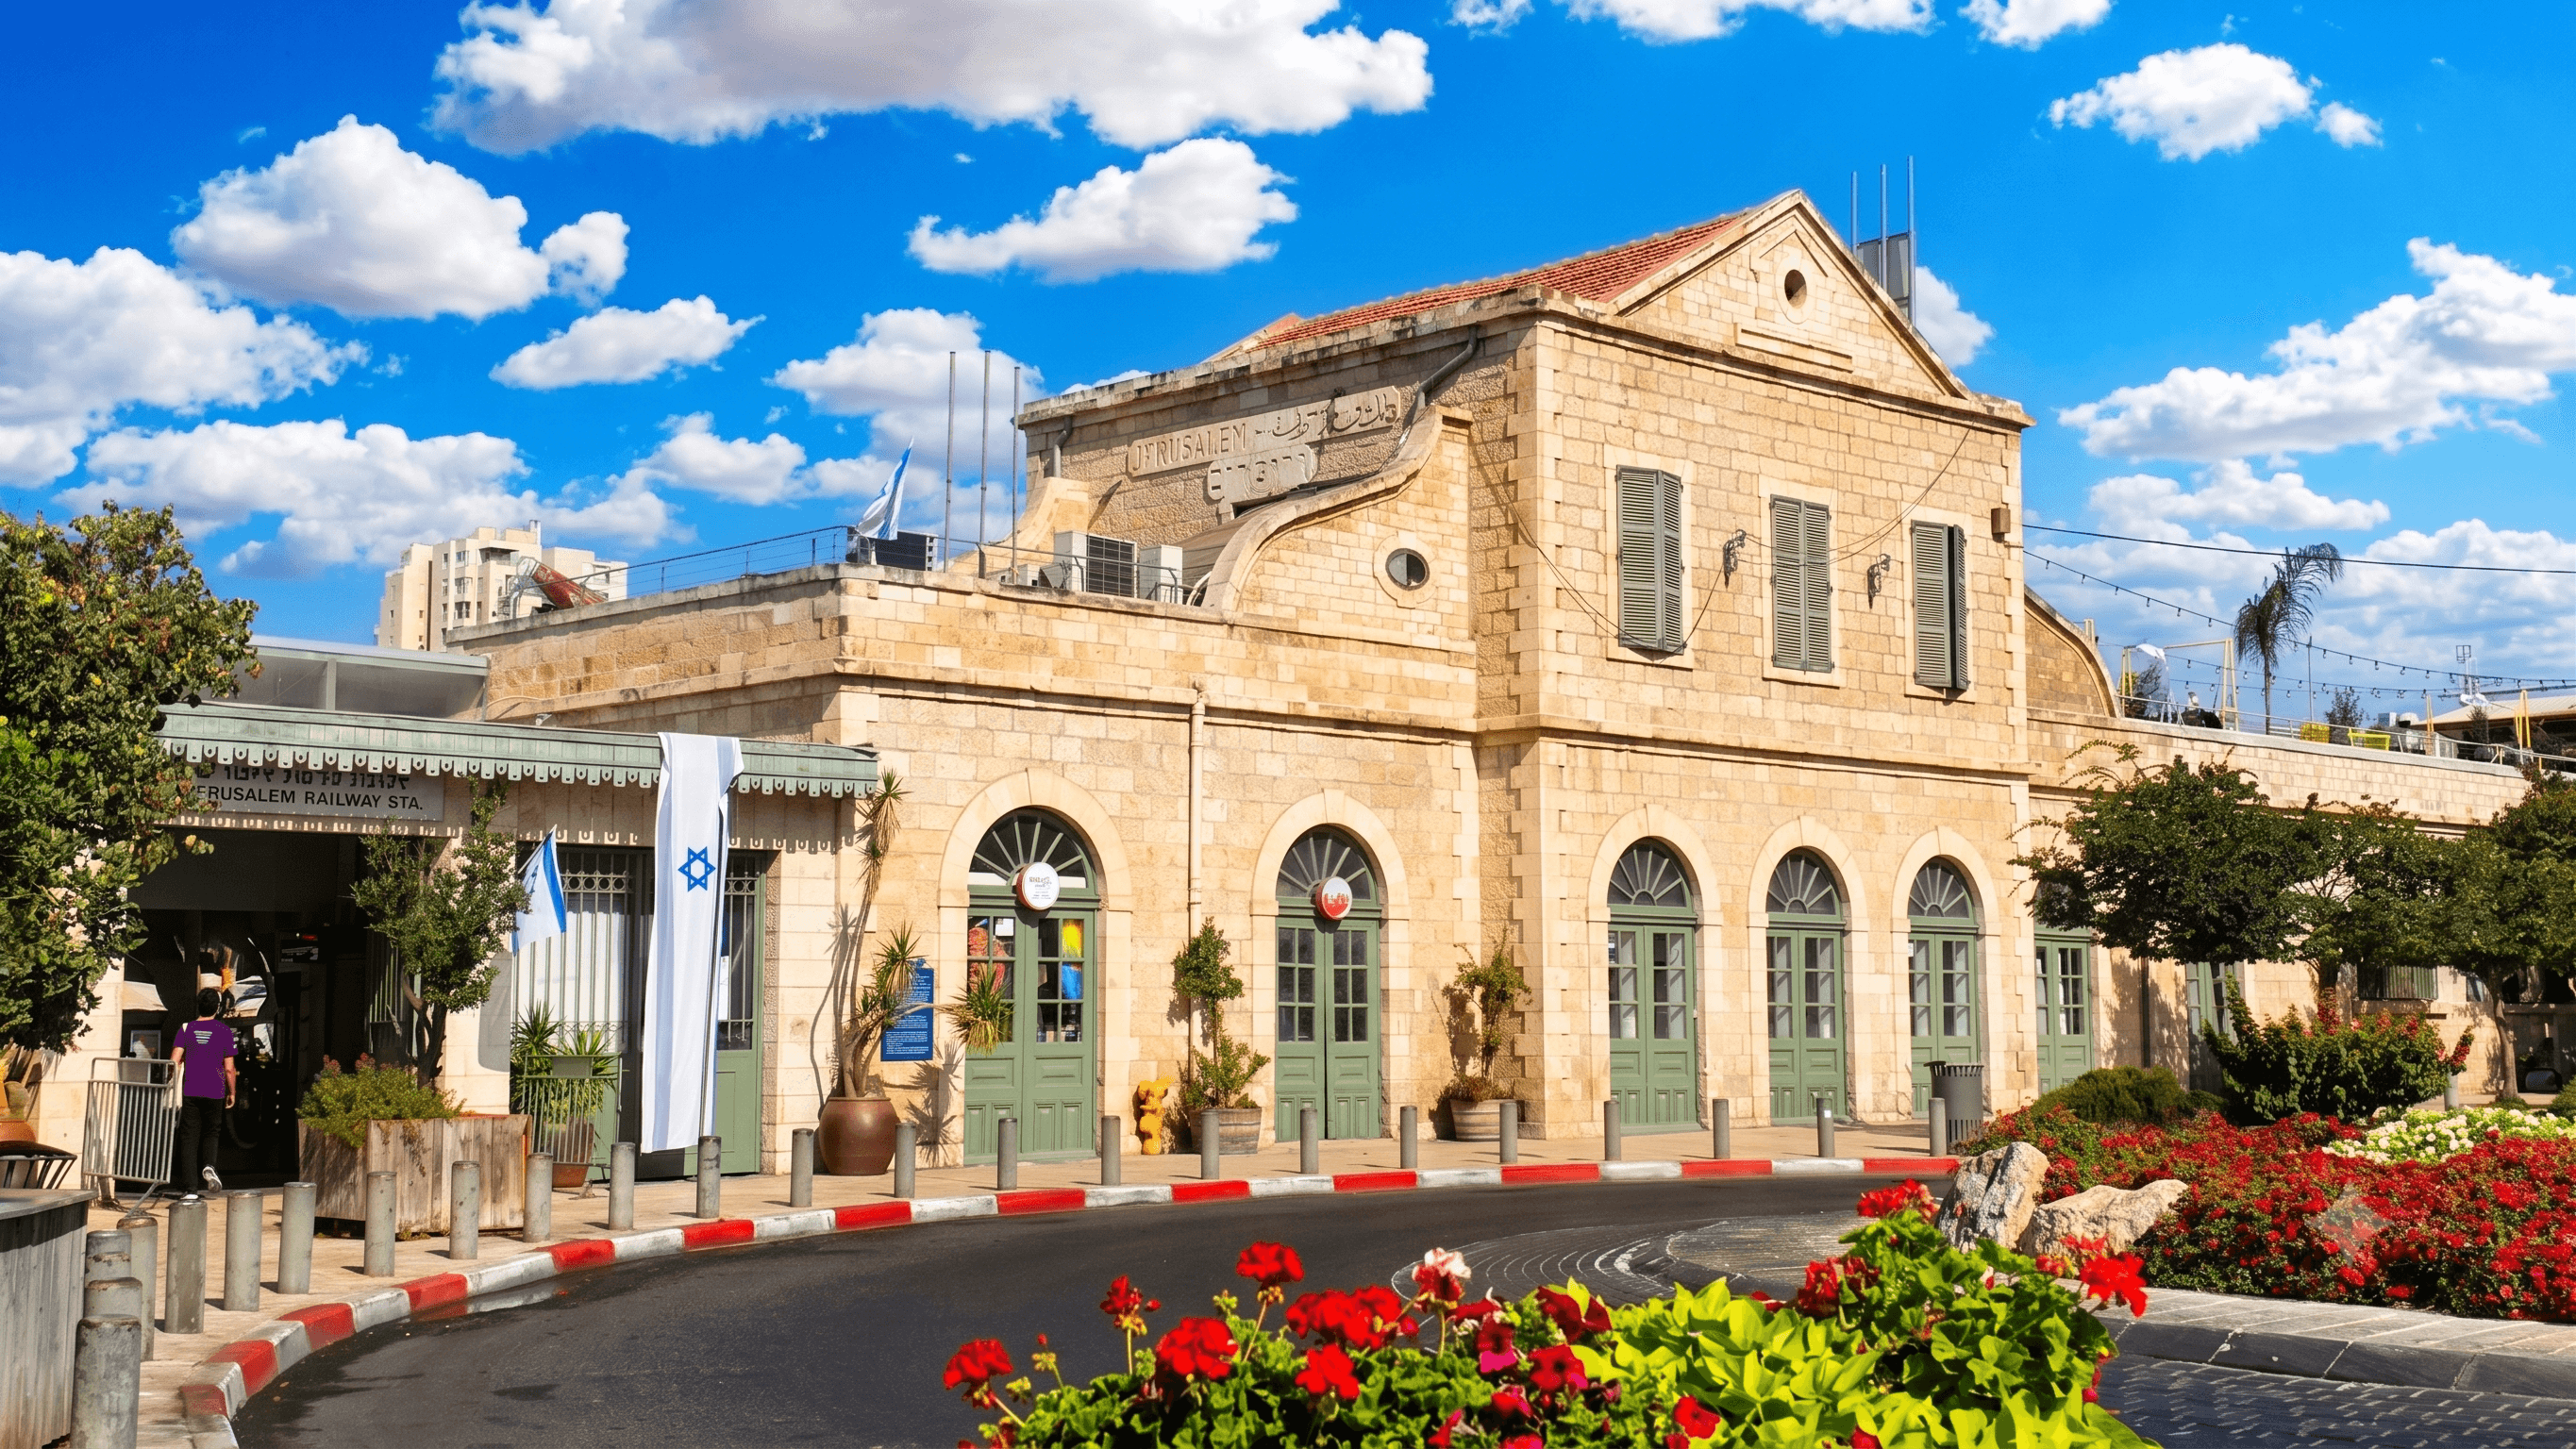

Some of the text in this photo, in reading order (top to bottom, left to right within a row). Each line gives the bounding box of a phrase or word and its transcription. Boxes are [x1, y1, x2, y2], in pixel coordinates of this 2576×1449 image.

[194, 785, 424, 811] ERUSALEM RAILWAY STA.
